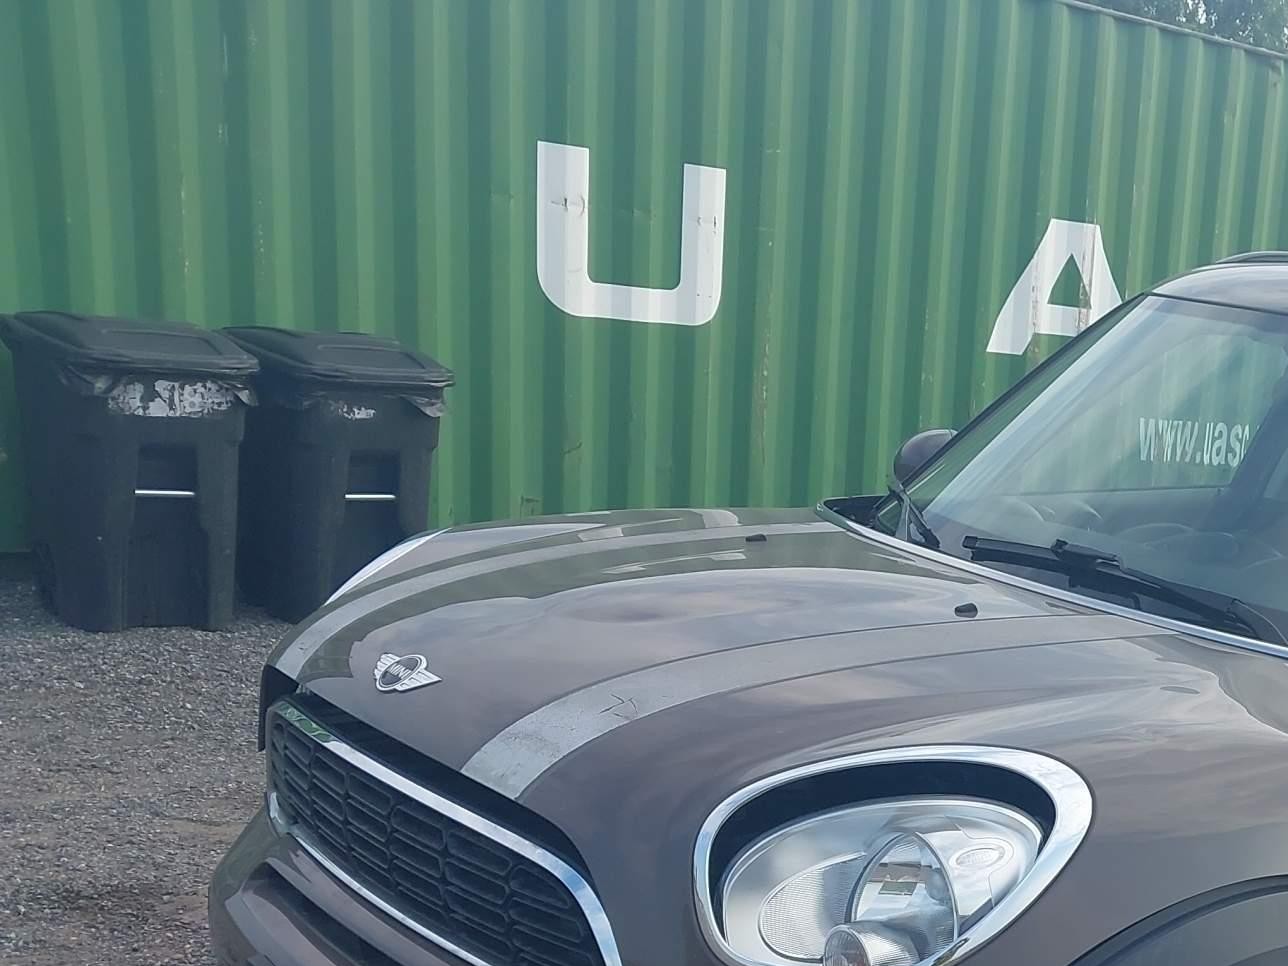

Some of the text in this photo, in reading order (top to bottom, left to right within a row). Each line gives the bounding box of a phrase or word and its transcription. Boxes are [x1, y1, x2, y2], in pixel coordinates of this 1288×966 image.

[537, 140, 1123, 355] U A
[1139, 417, 1259, 468] www.uasc
